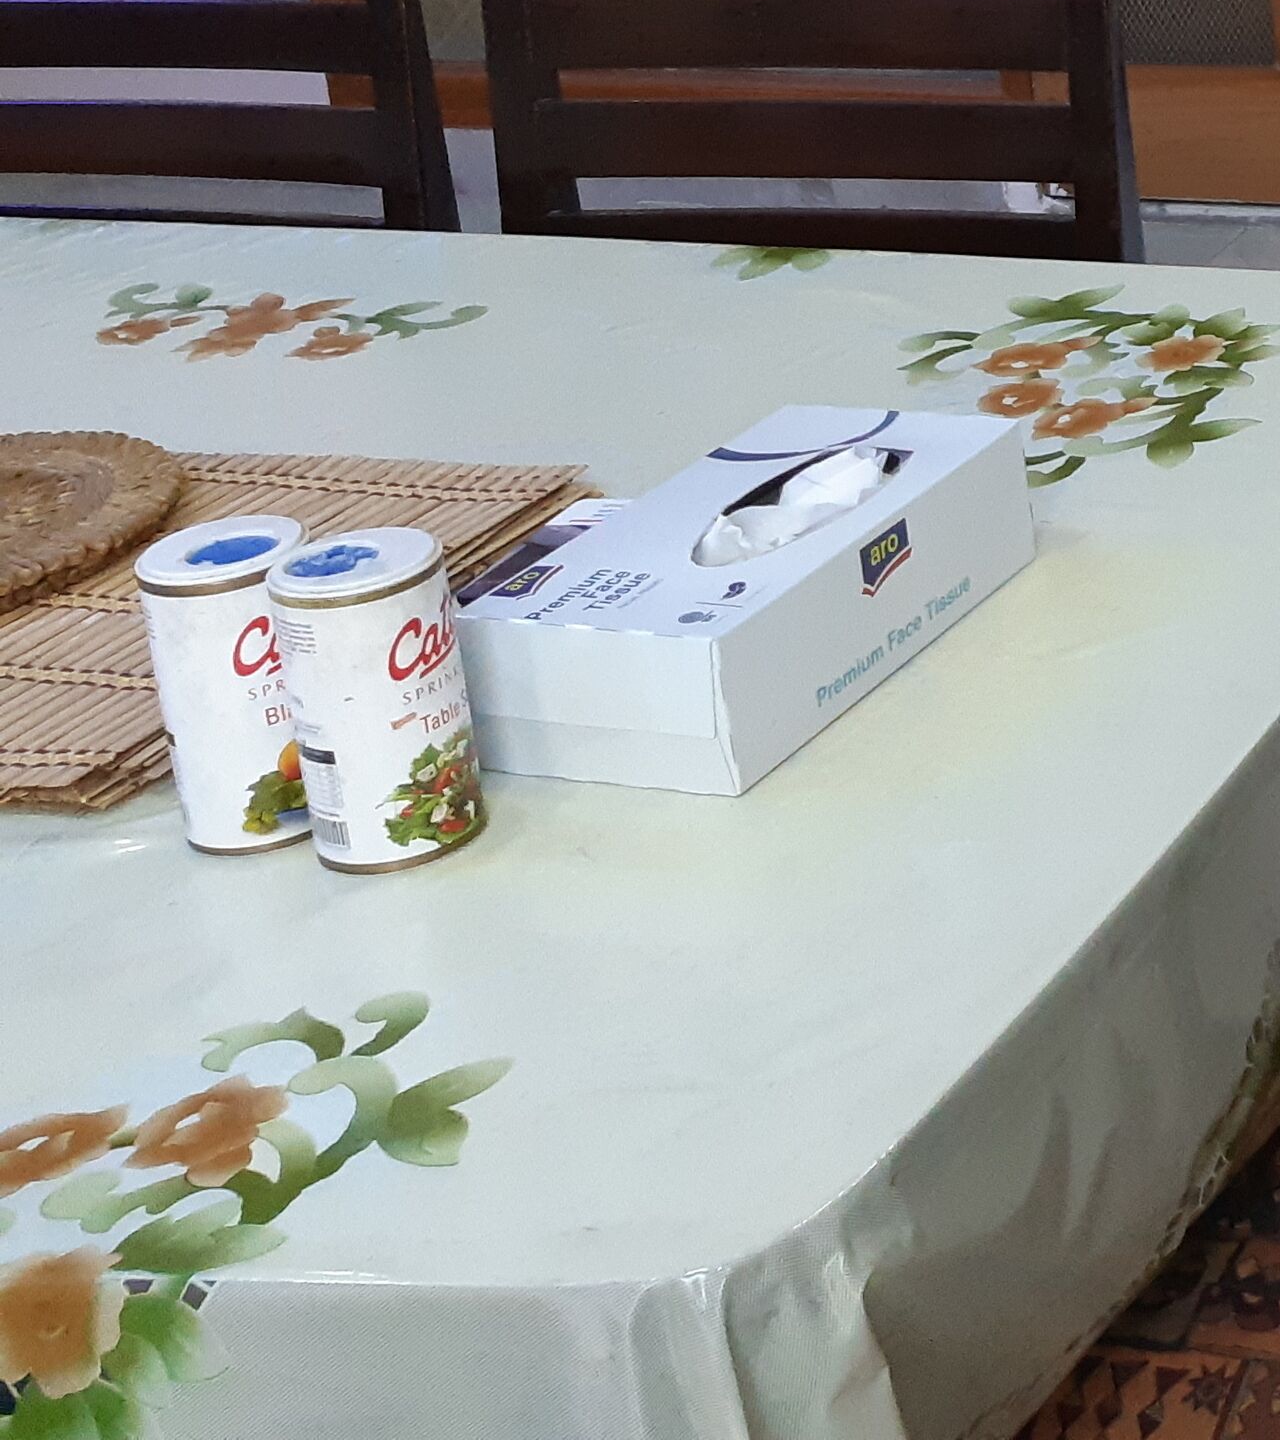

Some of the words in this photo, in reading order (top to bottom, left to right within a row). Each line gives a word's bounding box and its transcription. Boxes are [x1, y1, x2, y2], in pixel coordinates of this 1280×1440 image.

[870, 533, 899, 566] aro
[505, 571, 541, 592] aro
[524, 569, 612, 620] Premium
[580, 571, 631, 599] Face
[582, 573, 651, 611] Tissue
[816, 645, 885, 707] Premium
[888, 615, 923, 651] Face
[924, 576, 972, 621] Tissue
[420, 701, 462, 733] Table
